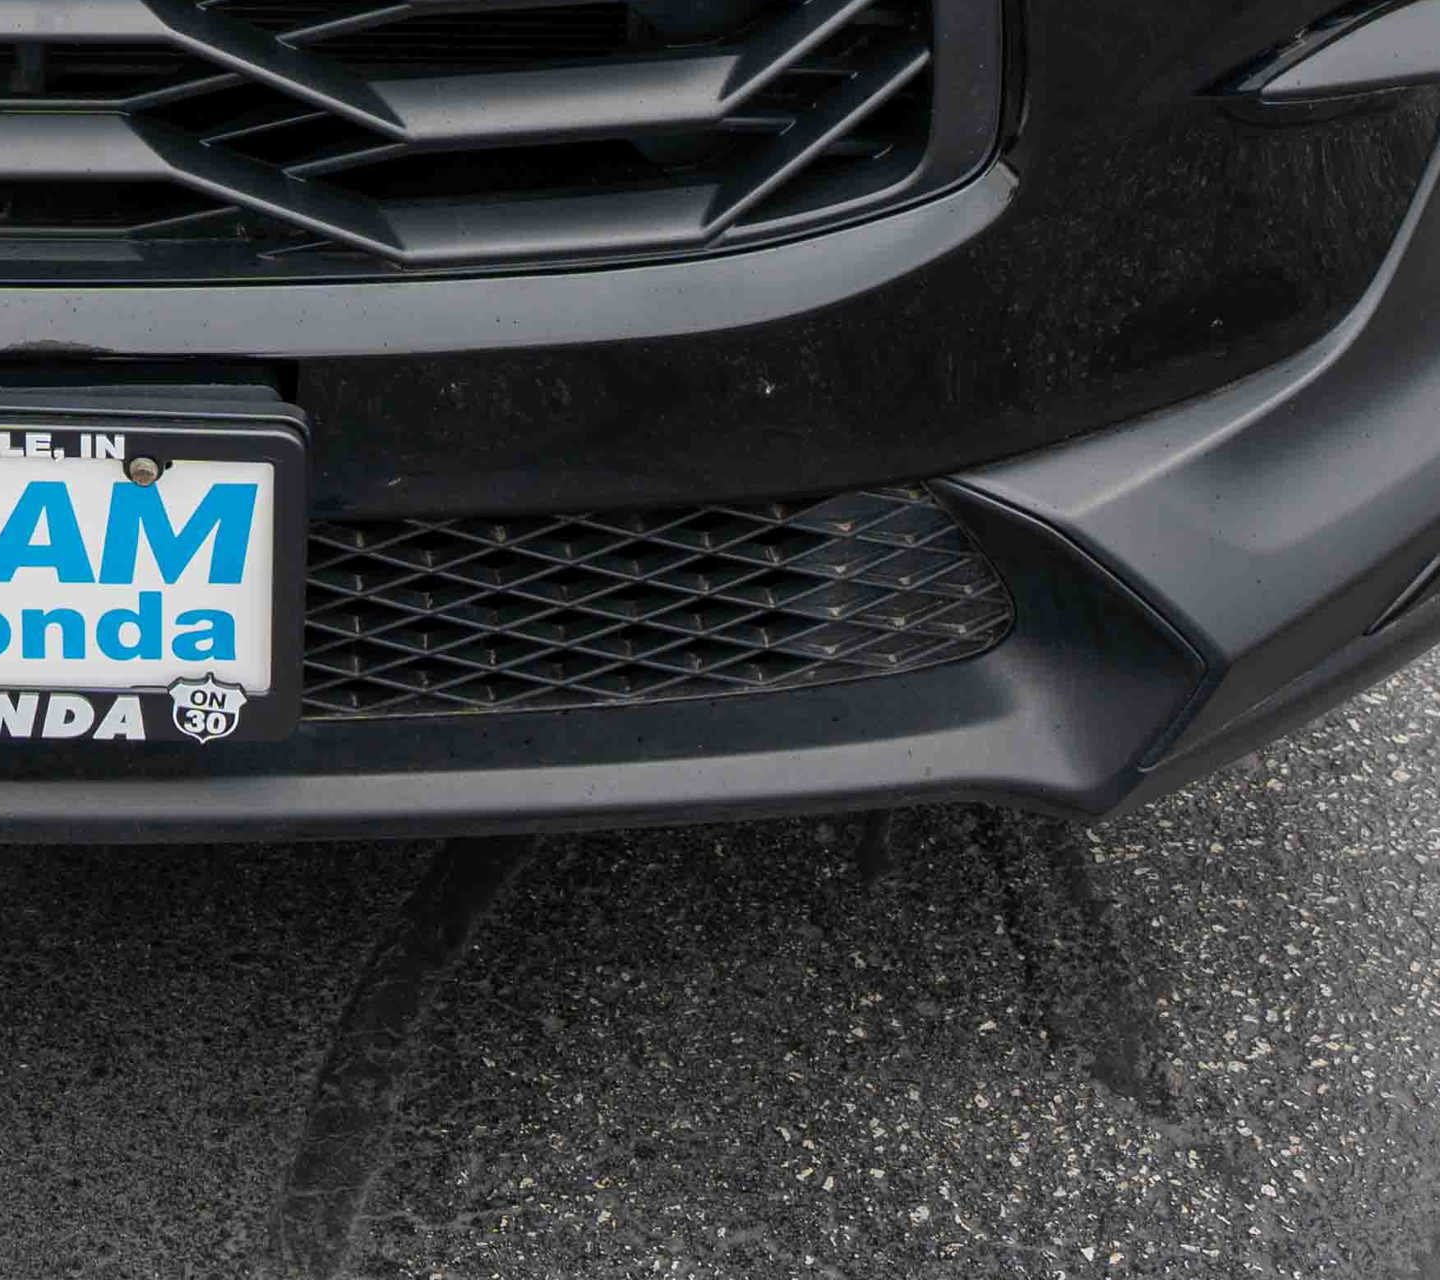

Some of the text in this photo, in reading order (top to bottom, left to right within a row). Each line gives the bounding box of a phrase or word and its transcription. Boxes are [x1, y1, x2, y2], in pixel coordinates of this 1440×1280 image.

[78, 432, 126, 460] IN
[190, 689, 227, 709] ON
[184, 711, 228, 734] 30
